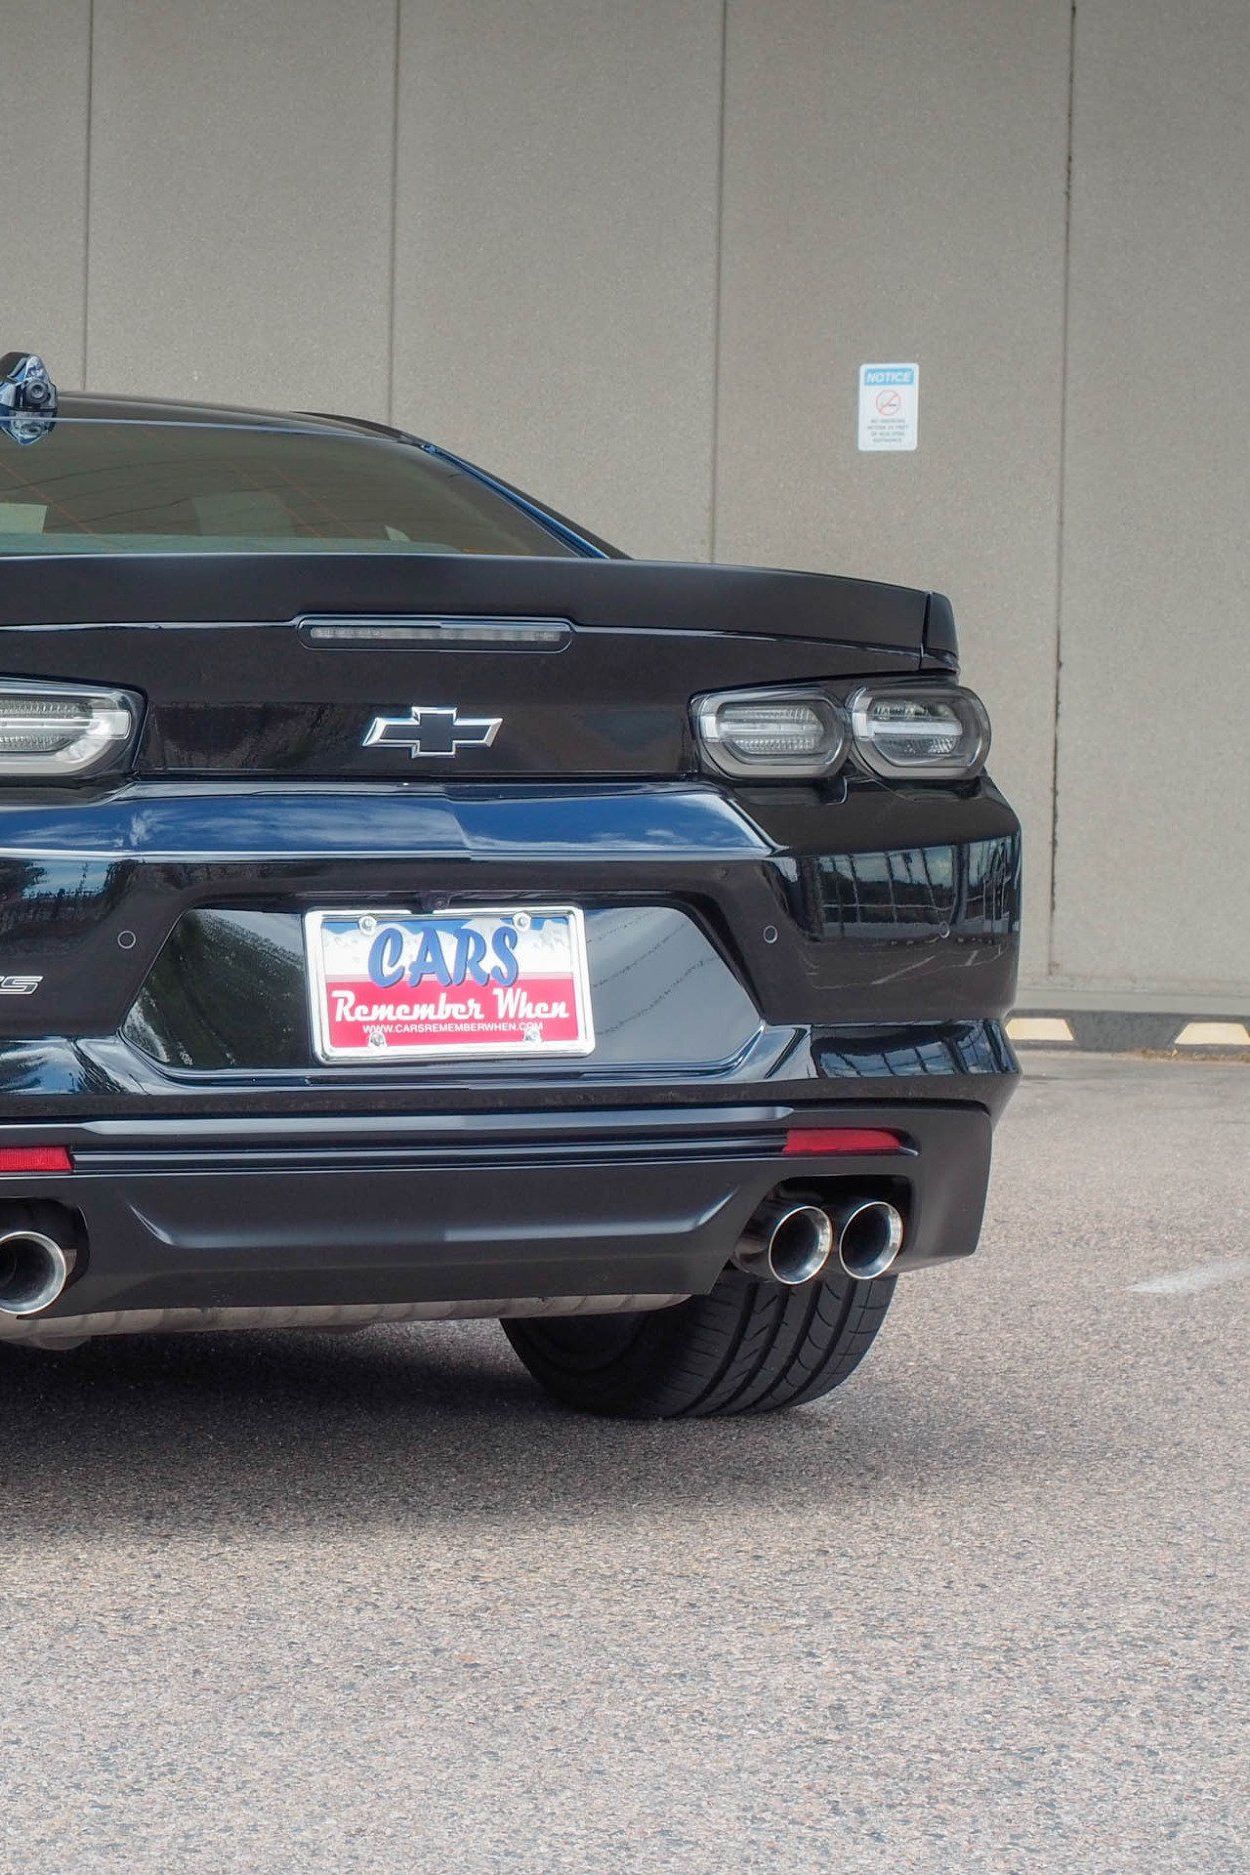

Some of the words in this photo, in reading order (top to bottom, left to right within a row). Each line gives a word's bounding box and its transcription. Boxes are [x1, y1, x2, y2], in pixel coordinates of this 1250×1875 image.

[866, 372, 911, 384] NOTICE
[368, 927, 519, 988] CARS
[331, 990, 485, 1022] Remember
[492, 988, 569, 1019] When
[363, 1021, 544, 1034] WWW.CARSREMEMBERWHEN.COM
